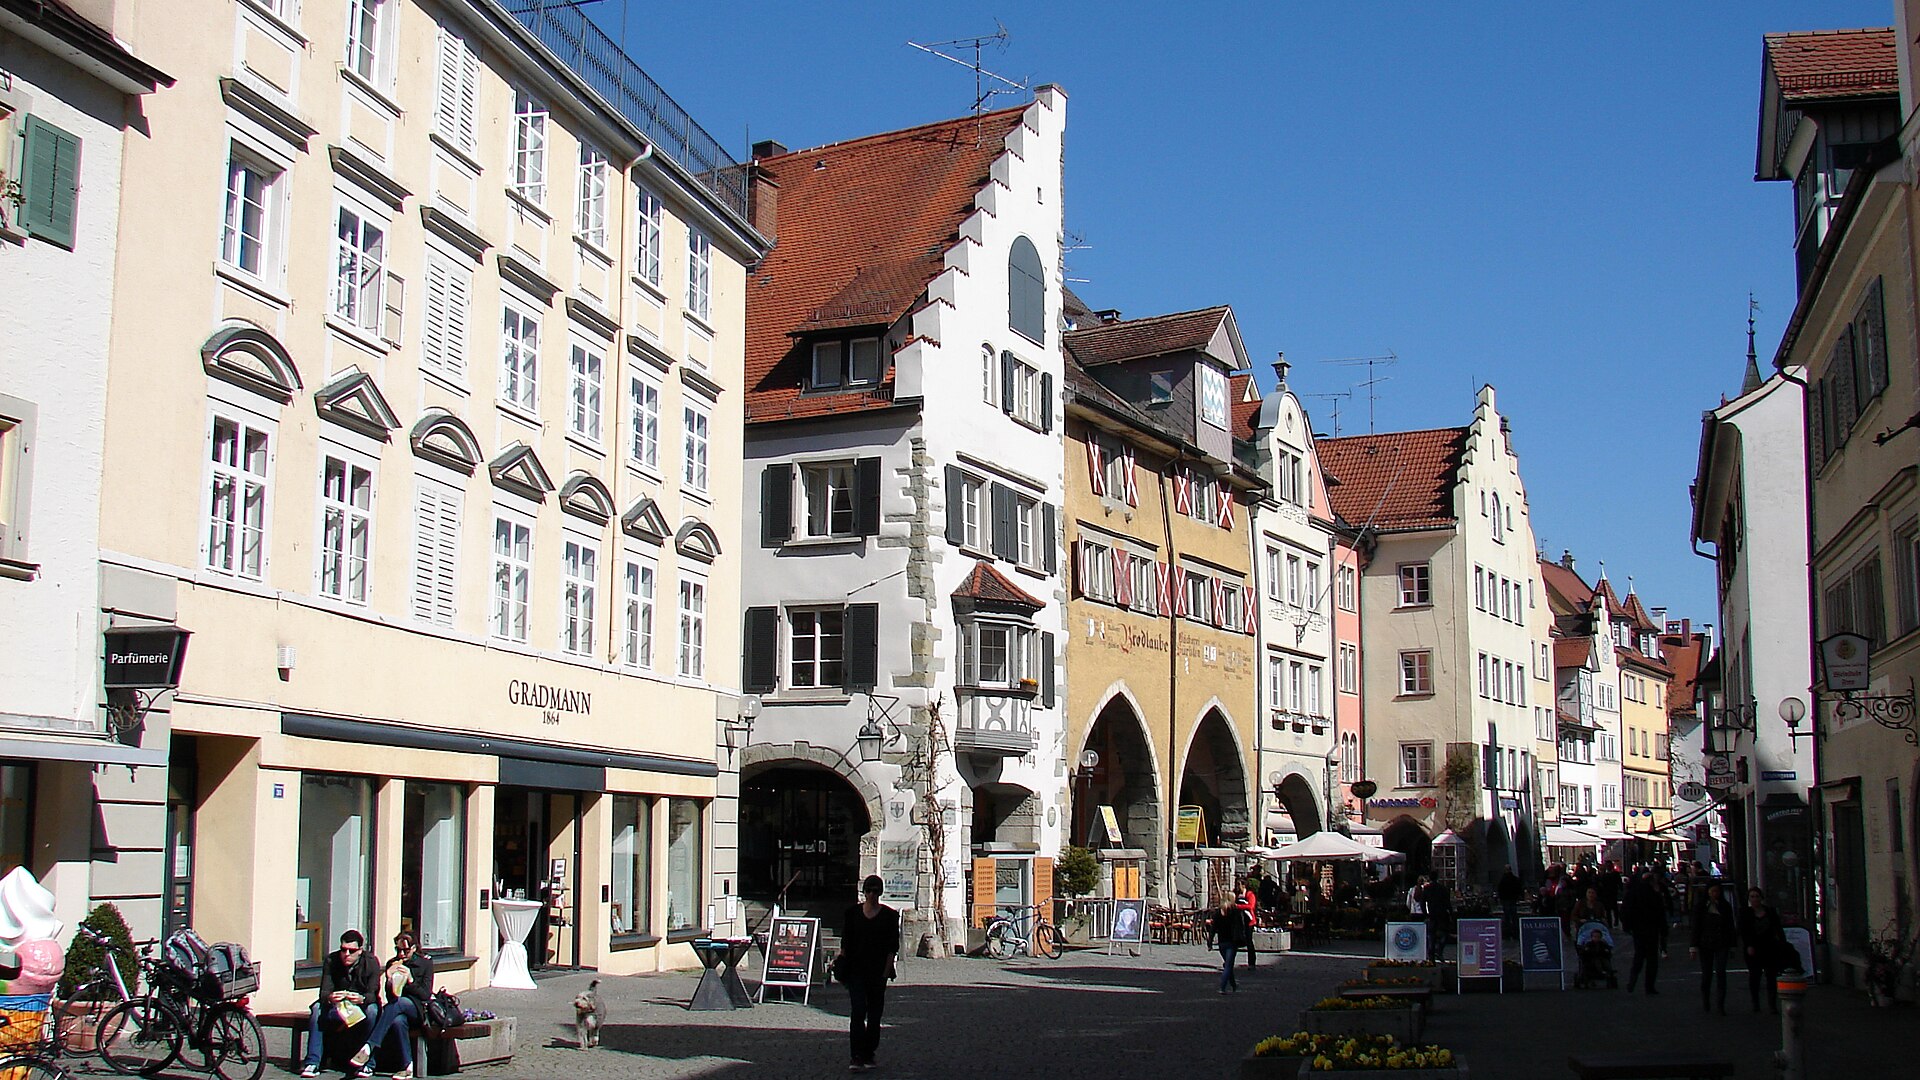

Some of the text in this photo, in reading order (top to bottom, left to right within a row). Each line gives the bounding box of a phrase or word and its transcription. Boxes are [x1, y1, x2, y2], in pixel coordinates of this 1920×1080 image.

[111, 652, 168, 664] Parfümerie
[508, 679, 592, 715] GRADMANN
[542, 710, 560, 725] 1864
[1369, 797, 1420, 808] NORDSEE
[1479, 926, 1496, 971] buch
